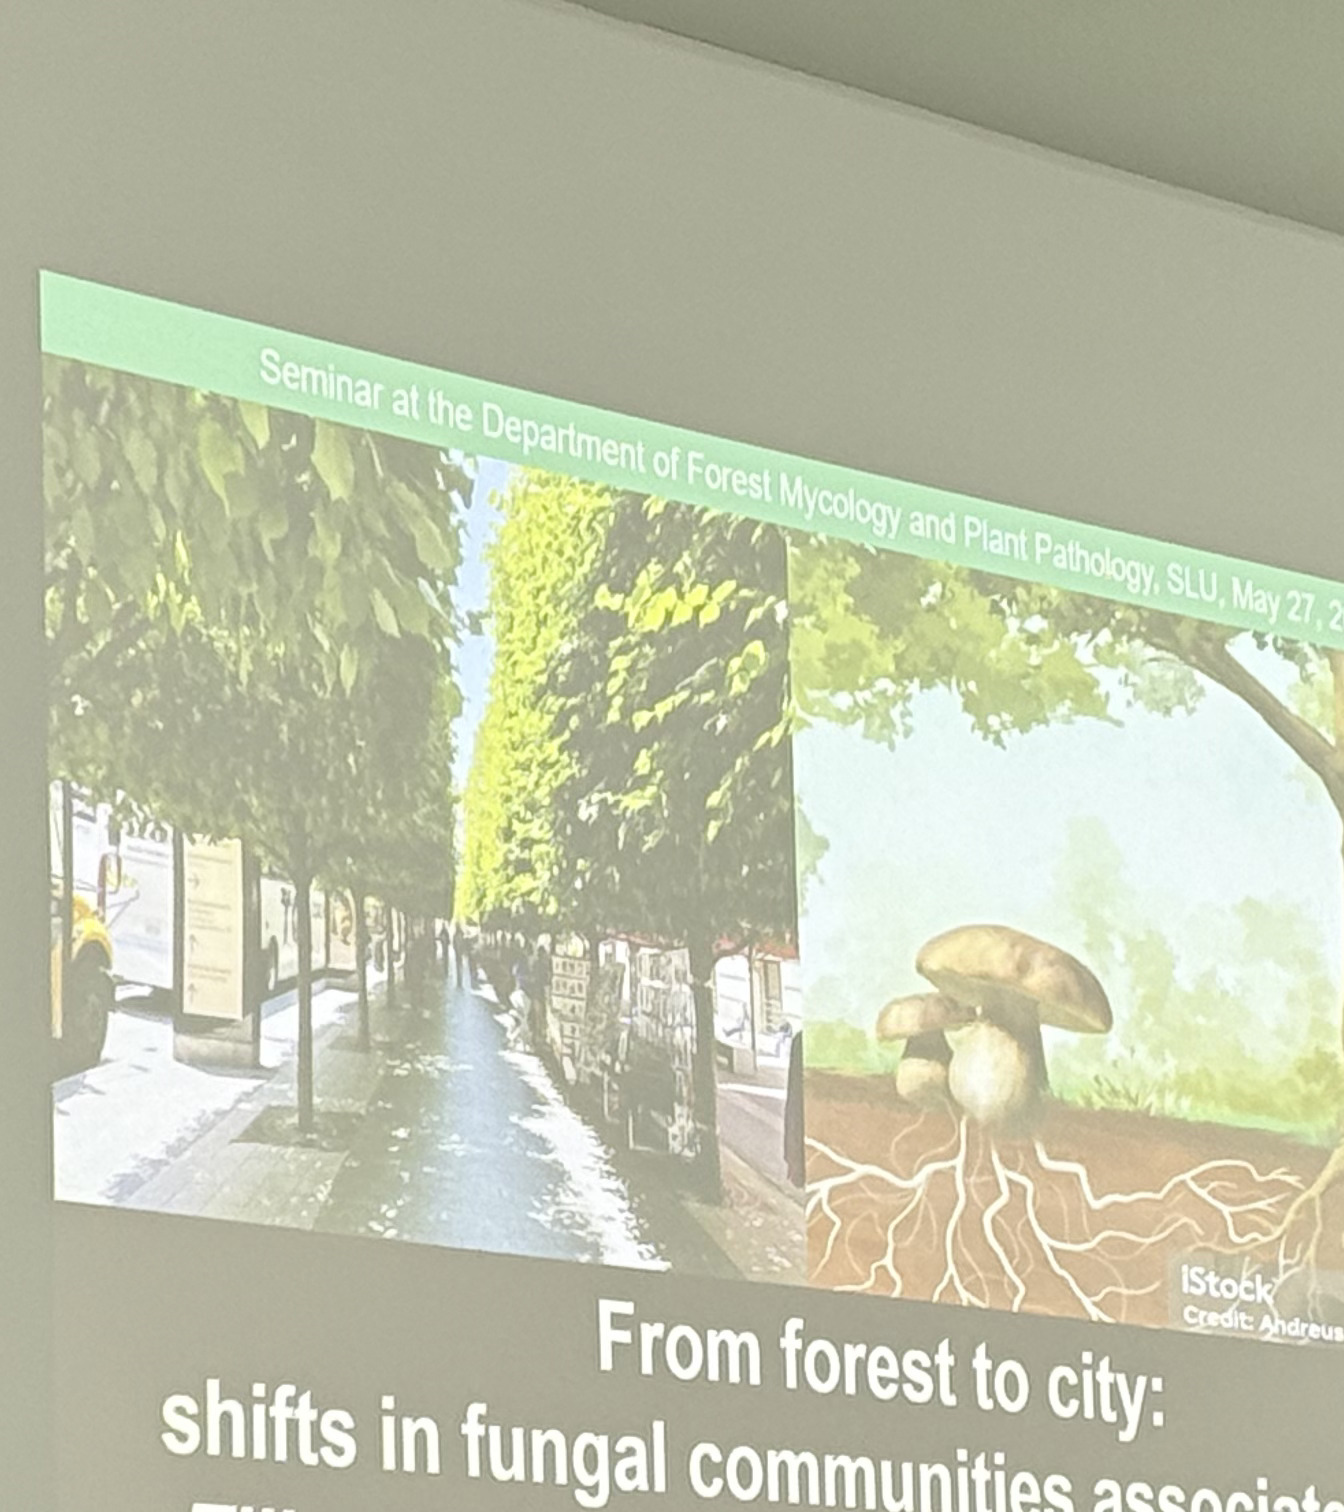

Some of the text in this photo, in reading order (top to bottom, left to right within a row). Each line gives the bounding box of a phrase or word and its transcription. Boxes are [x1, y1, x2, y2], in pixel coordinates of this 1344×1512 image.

[260, 348, 384, 410] Seminar
[393, 385, 419, 421] at
[428, 389, 473, 431] the
[482, 402, 646, 472] Department
[653, 447, 681, 480] of
[688, 451, 772, 501] Forest
[780, 472, 901, 539] Mycology
[910, 511, 956, 544] and
[965, 516, 1028, 561] Plant
[1036, 532, 1159, 595] Pathology,
[1167, 564, 1225, 609] SLU,
[1233, 576, 1280, 625] May
[1288, 591, 1323, 632] 27,
[598, 1299, 1164, 1442] From forest to city:
[1259, 1315, 1344, 1342] Andreus
[161, 1378, 356, 1468] shifts
[381, 1395, 440, 1474] in
[461, 1402, 667, 1508] fungal
